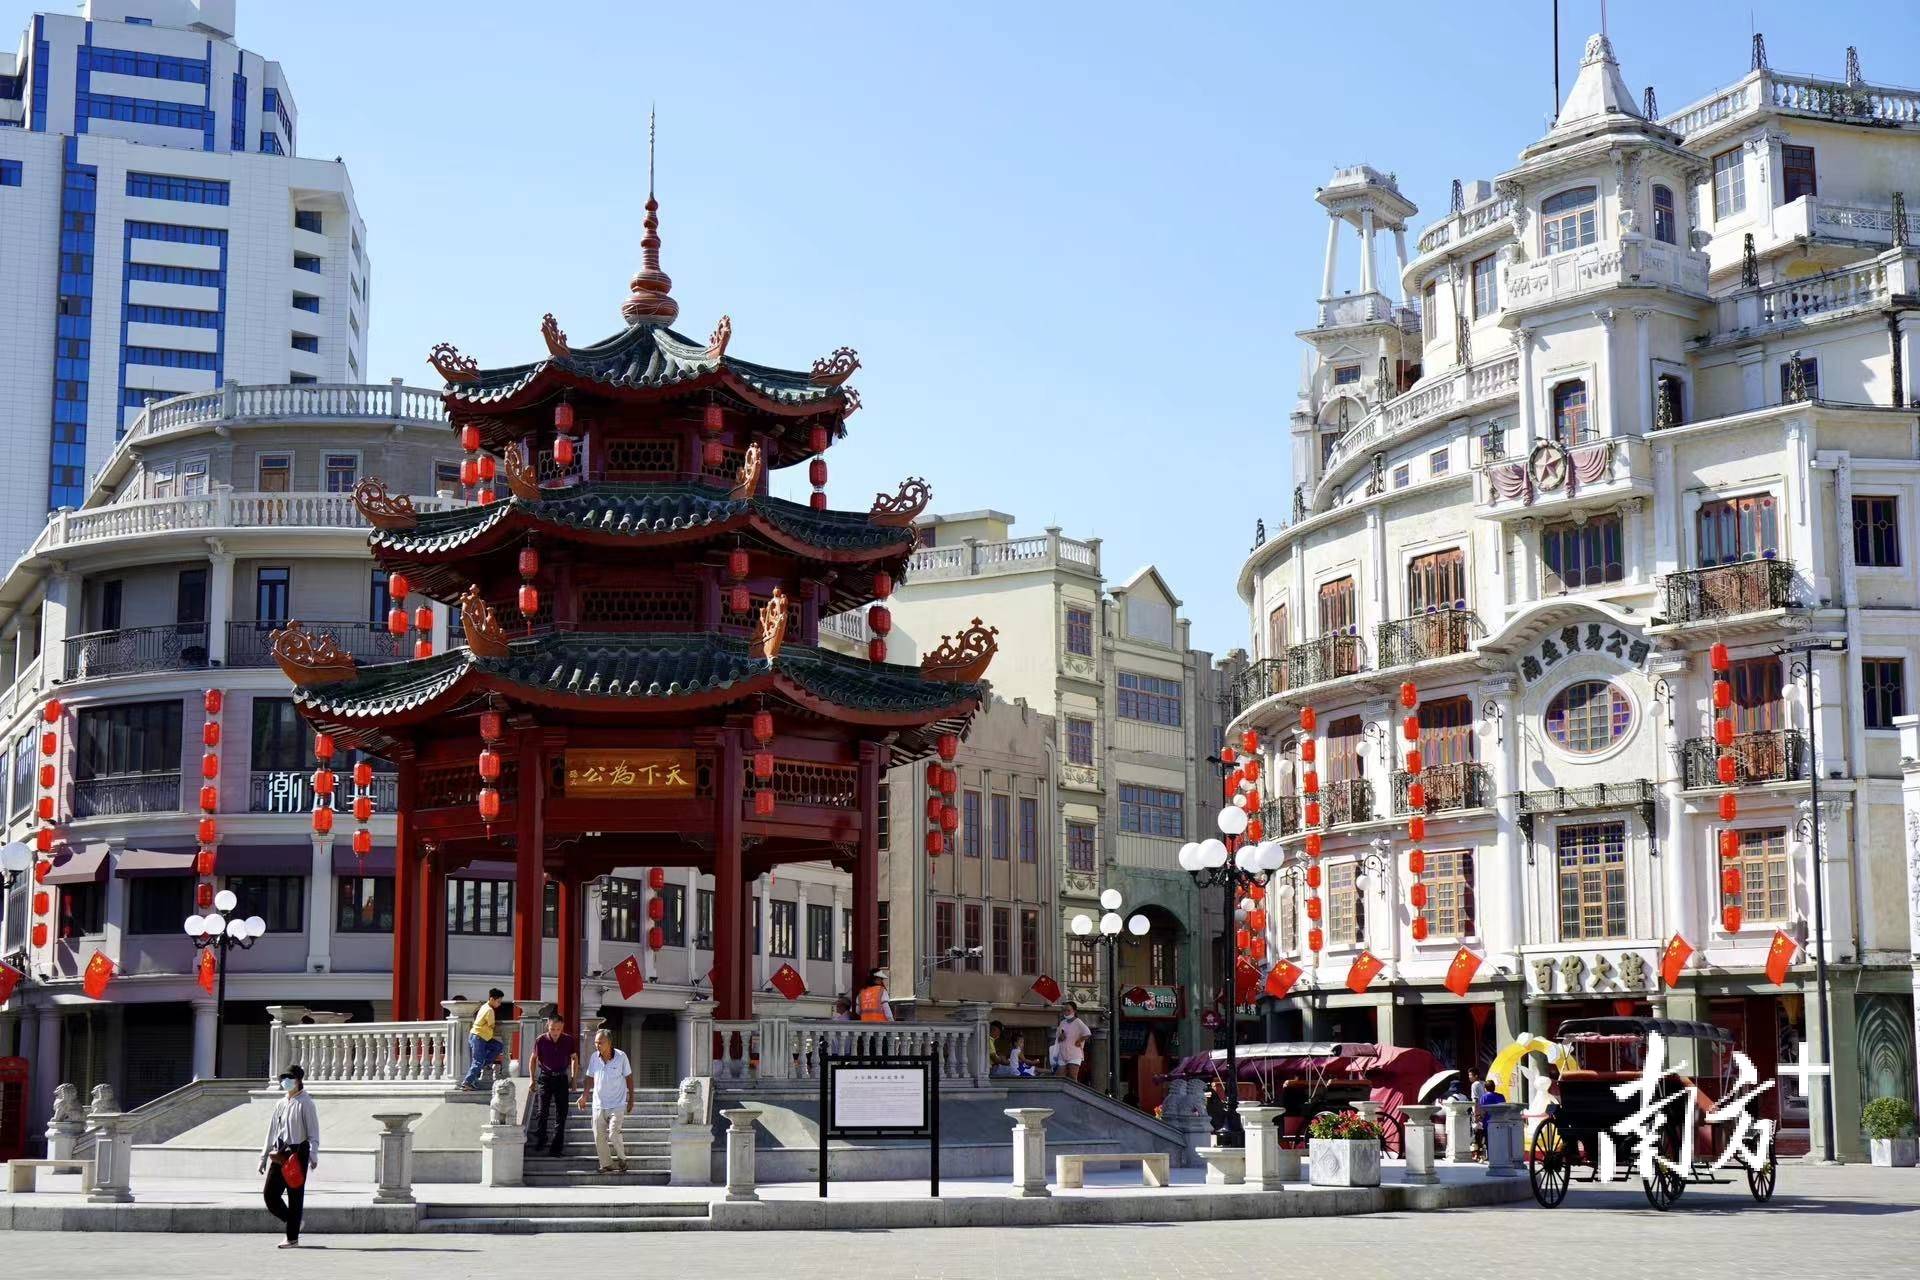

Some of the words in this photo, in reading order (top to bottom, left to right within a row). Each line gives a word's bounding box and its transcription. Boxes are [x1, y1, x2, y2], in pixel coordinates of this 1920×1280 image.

[1521, 623, 1651, 682] 南生貿易公司
[582, 760, 689, 786] 天下為公
[1531, 951, 1648, 993] 百貨大樓
